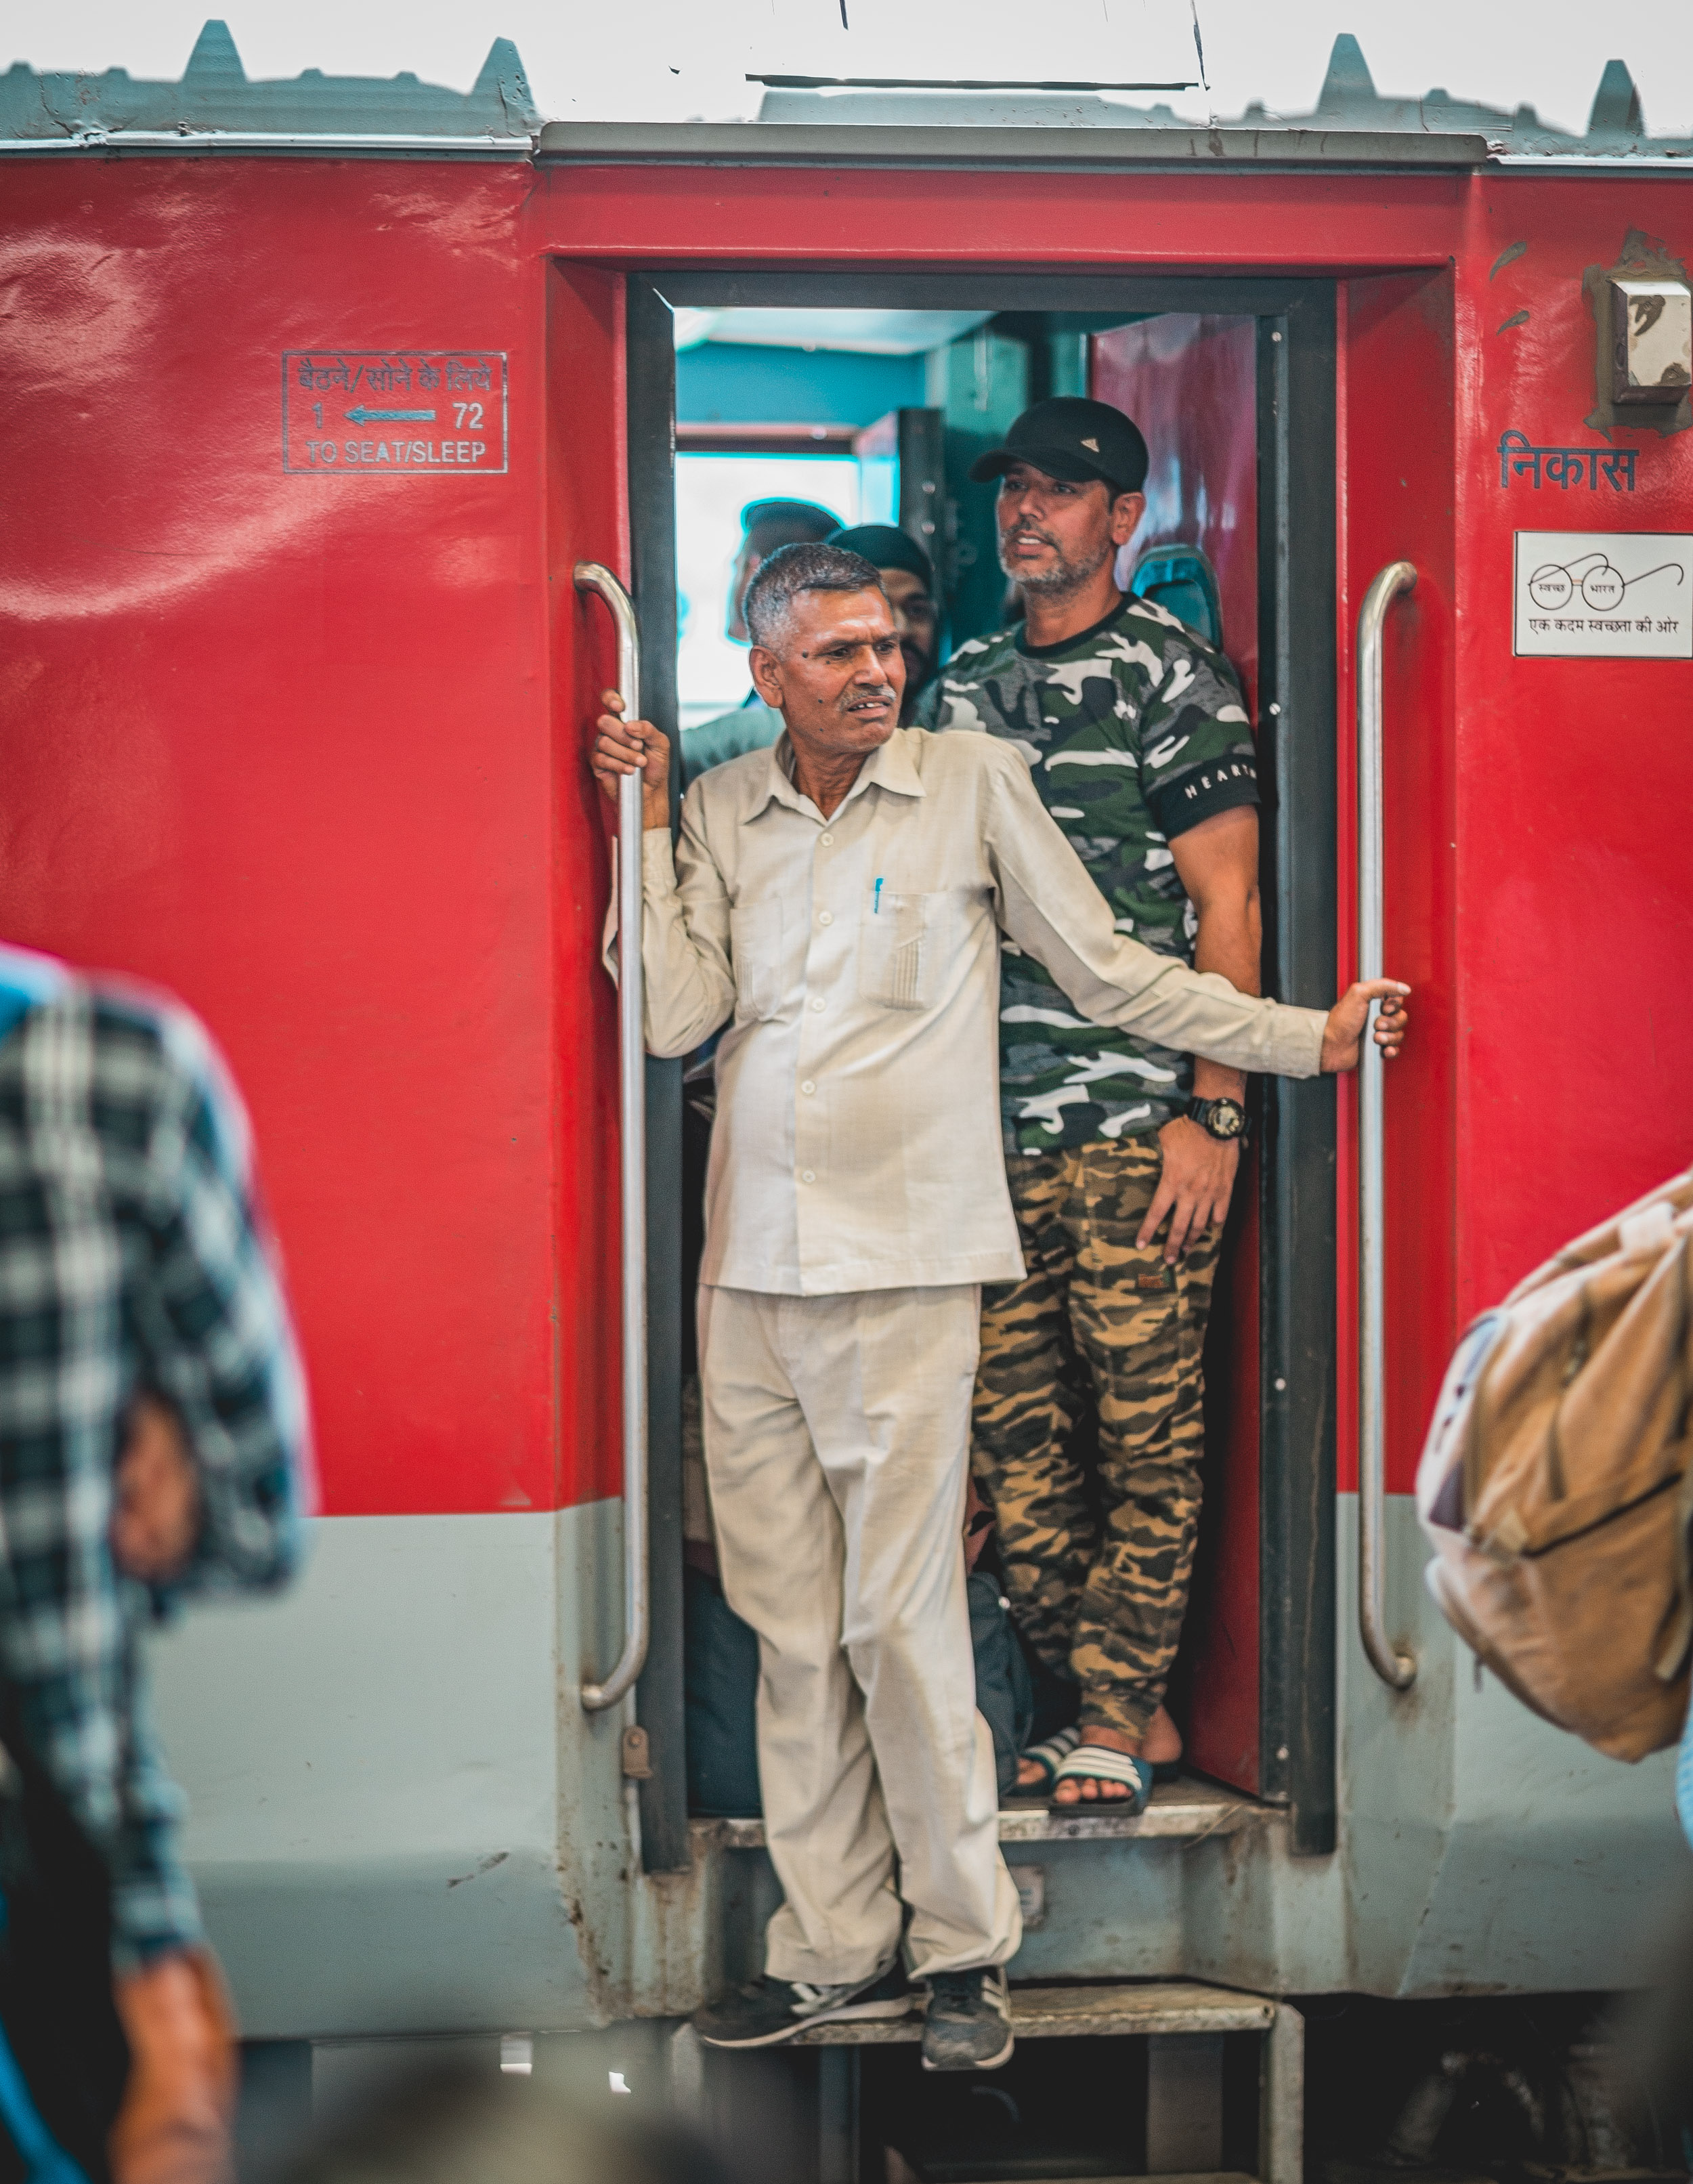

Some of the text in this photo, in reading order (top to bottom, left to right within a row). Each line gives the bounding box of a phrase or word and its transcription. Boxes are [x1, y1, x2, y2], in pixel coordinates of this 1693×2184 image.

[418, 358, 441, 391] के
[446, 358, 492, 391] लिये
[312, 402, 484, 429] 1 72
[306, 441, 486, 463] TO SEAT/SLEEP
[1497, 430, 1640, 492] निकास
[1590, 584, 1615, 594] भारत
[1528, 616, 1679, 635] एक कदम स्वच्छता की ओर
